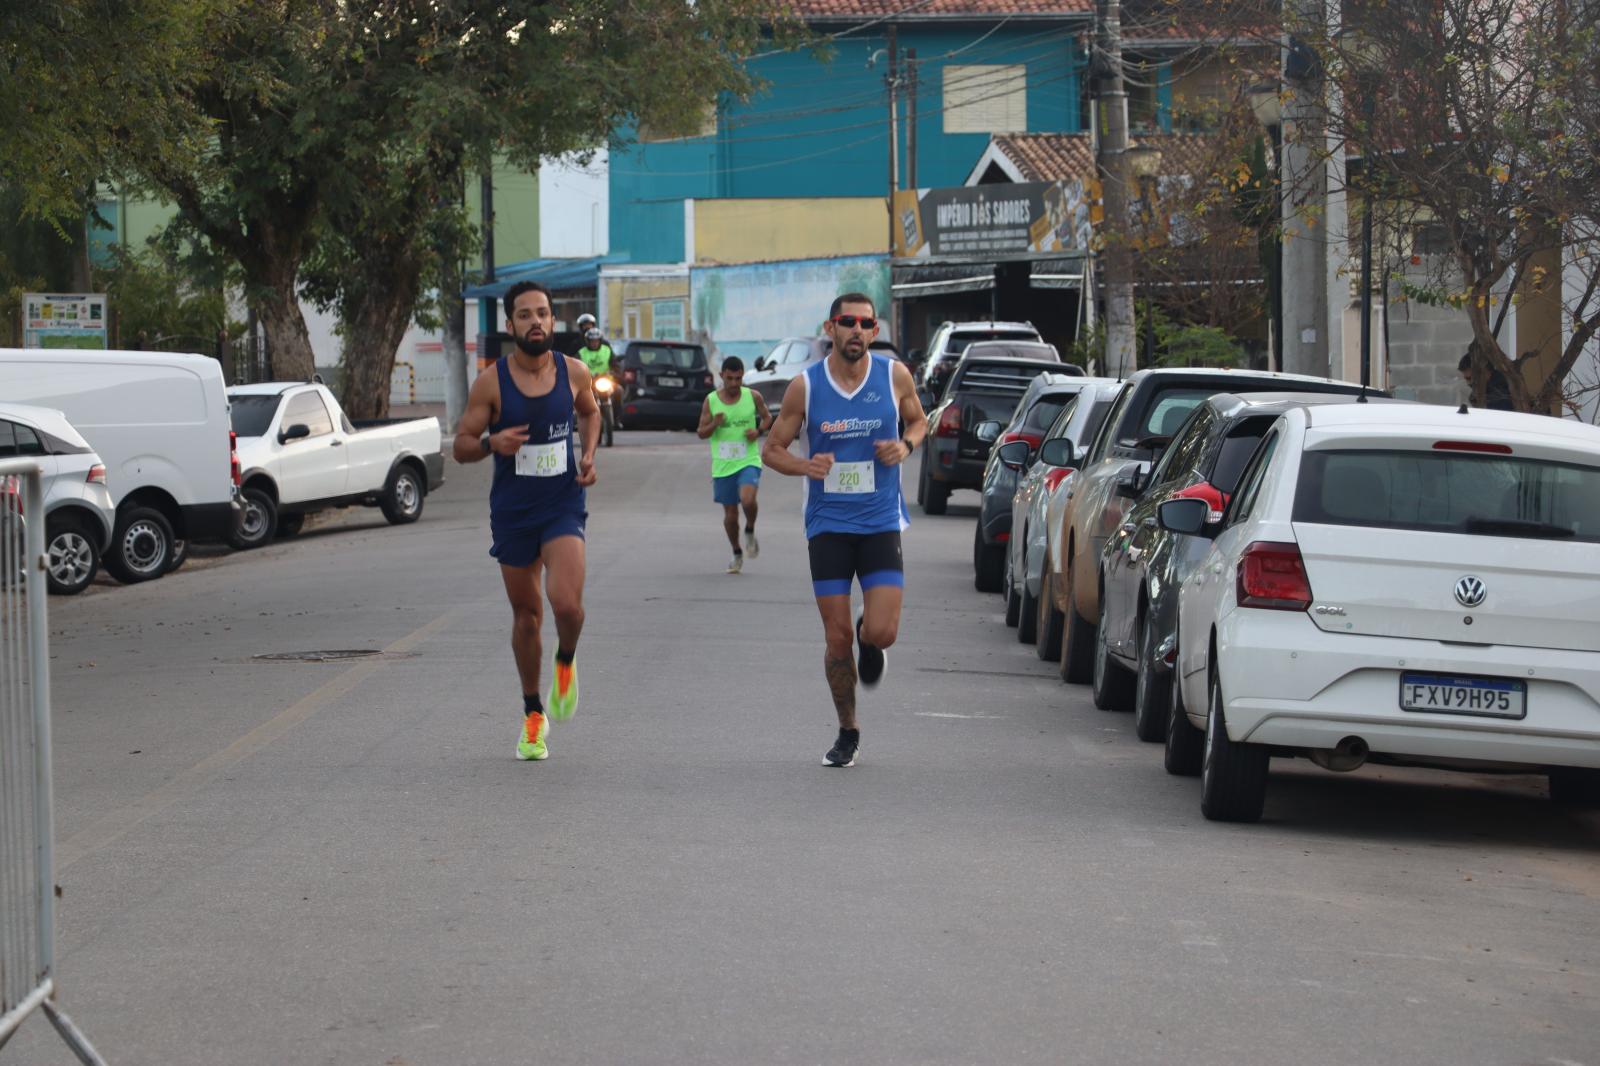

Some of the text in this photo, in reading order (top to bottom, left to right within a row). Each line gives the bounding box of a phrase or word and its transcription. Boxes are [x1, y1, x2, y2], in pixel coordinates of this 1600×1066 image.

[937, 197, 971, 228] IMPÉRIO
[993, 198, 1031, 225] SABORES
[537, 454, 557, 469] 215
[839, 472, 860, 486] 220
[1315, 605, 1347, 617] GOL
[1412, 685, 1510, 711] FXV9H95
